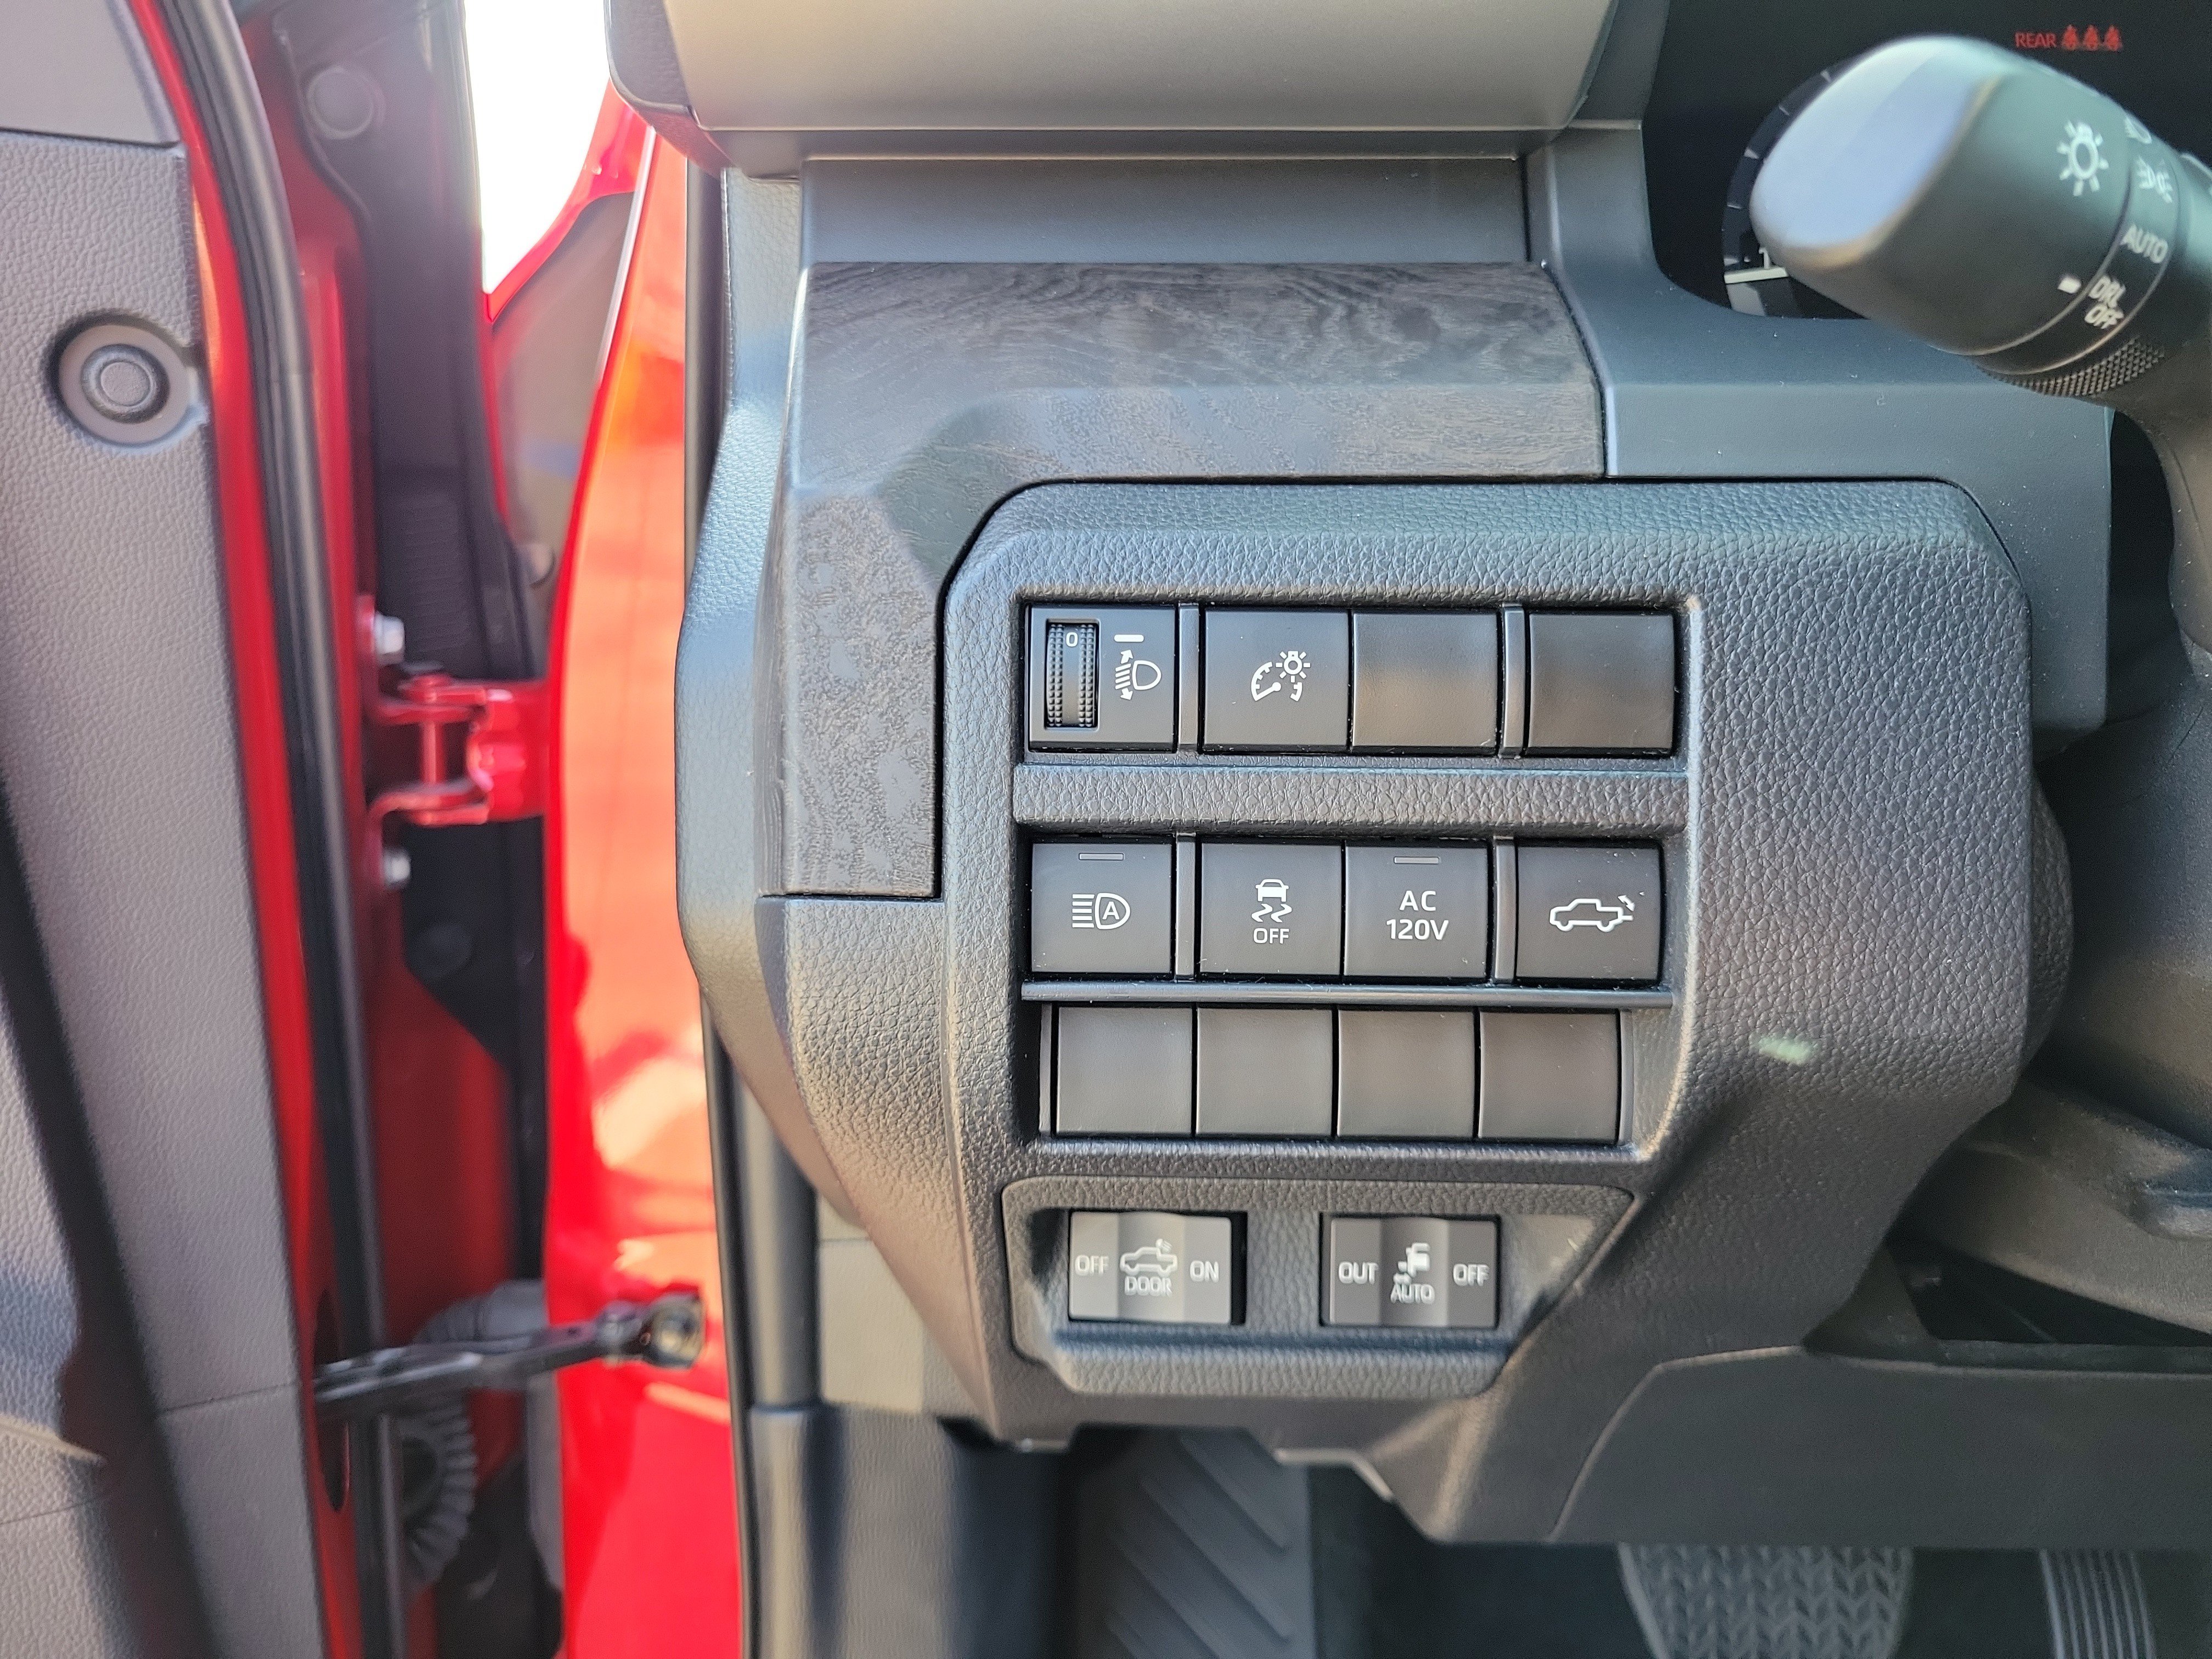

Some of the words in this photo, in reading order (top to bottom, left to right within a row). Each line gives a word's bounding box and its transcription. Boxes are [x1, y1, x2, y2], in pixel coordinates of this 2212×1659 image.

[2015, 32, 2057, 48] REAR
[2120, 224, 2168, 263] AUTO
[2089, 276, 2126, 308] DRL
[2085, 303, 2124, 329] OFF
[1066, 632, 1078, 647] 0
[1102, 901, 1120, 920] A
[1399, 890, 1436, 912] AC
[1253, 927, 1290, 945] OFF
[1386, 919, 1449, 941] 120V
[1076, 1255, 1109, 1276] OFF
[1189, 1260, 1219, 1283] ON
[1338, 1261, 1378, 1285] OUT
[1452, 1263, 1489, 1286] OFF
[1124, 1276, 1173, 1297] DOOR
[1390, 1284, 1436, 1304] AUTO
